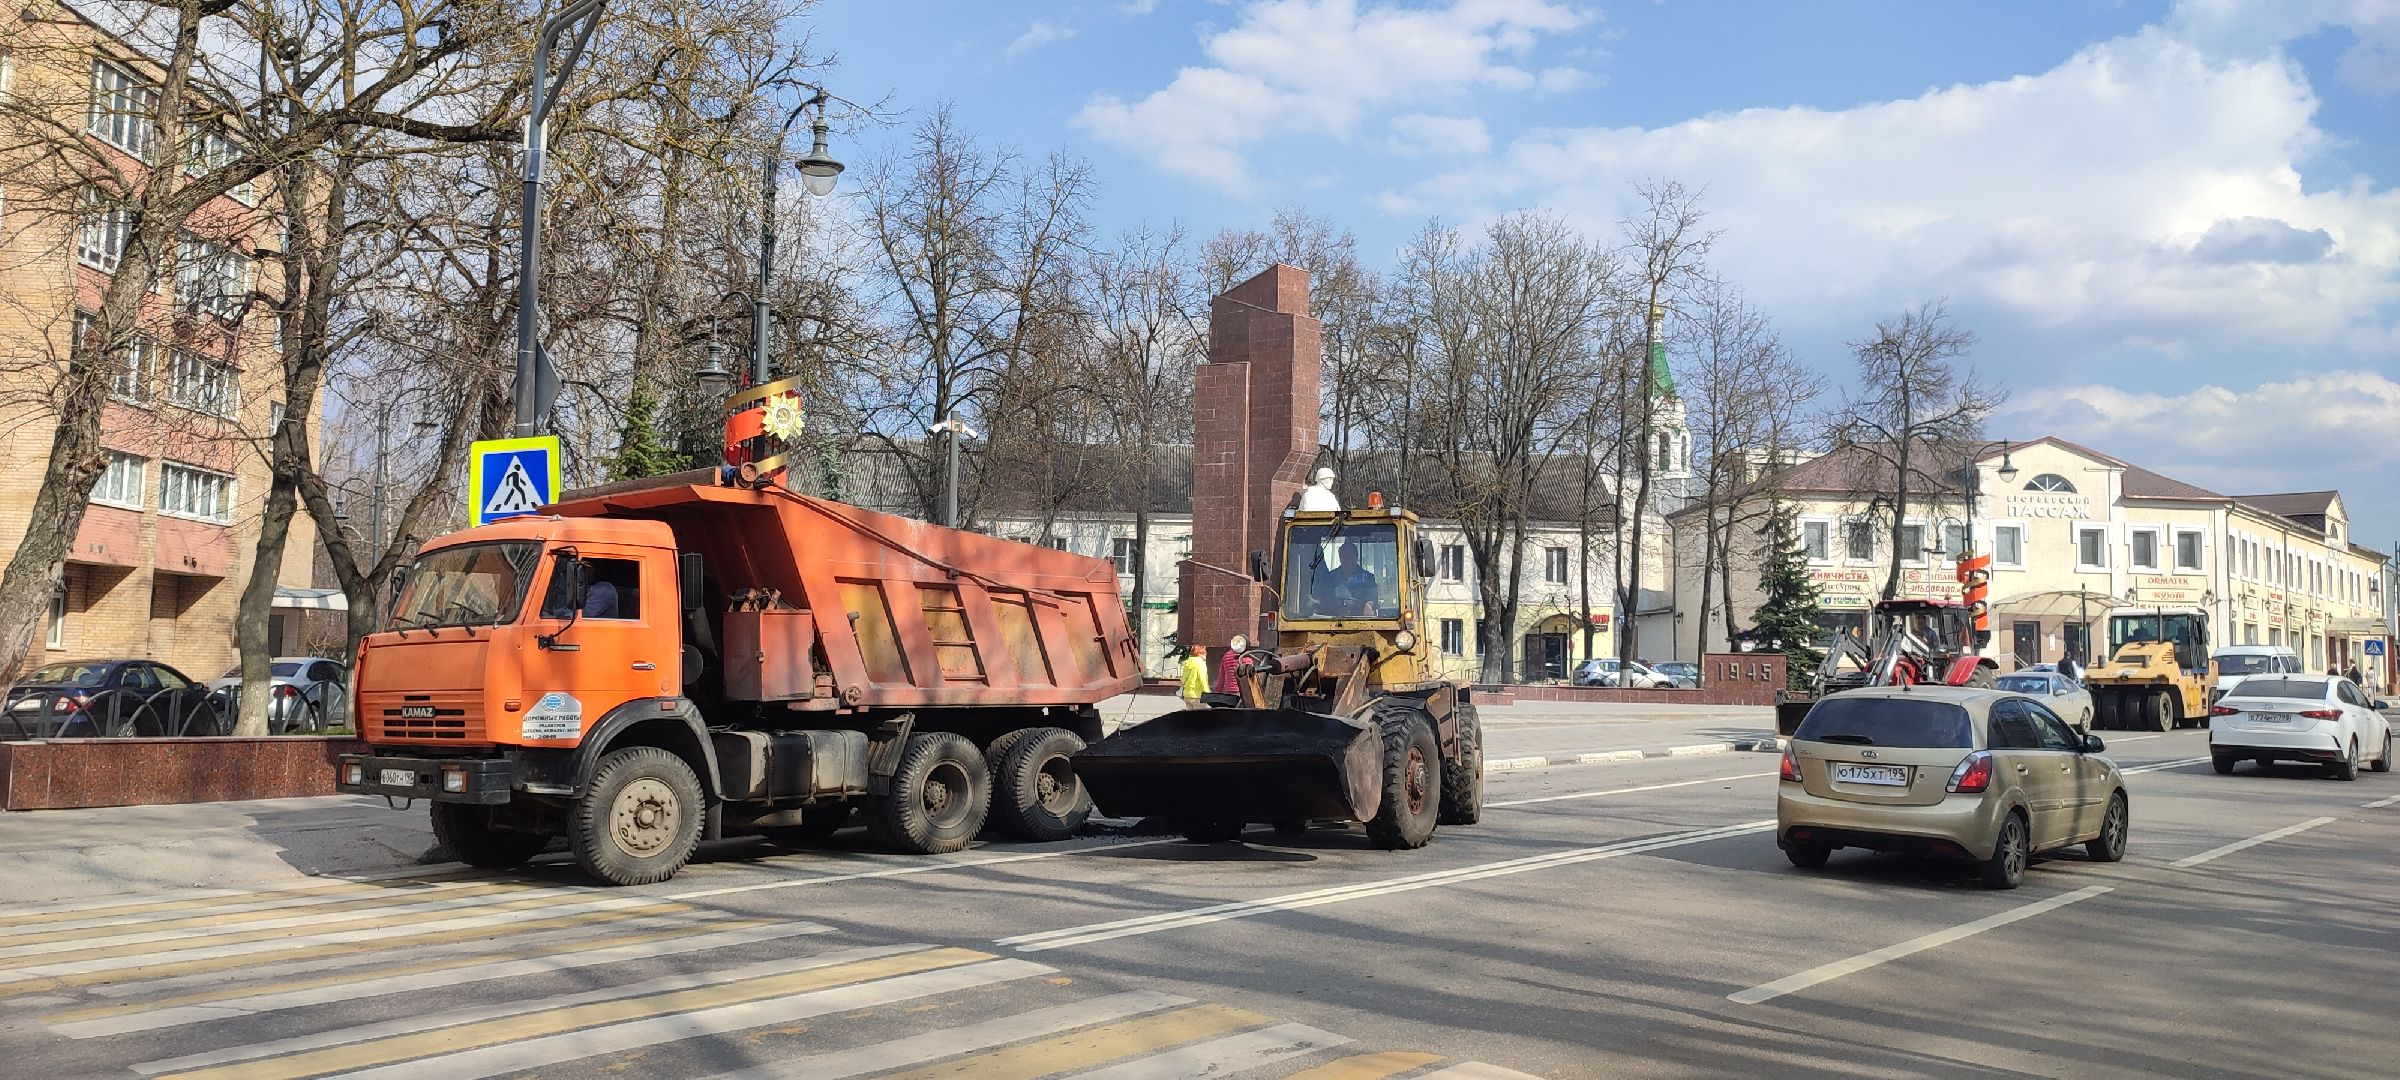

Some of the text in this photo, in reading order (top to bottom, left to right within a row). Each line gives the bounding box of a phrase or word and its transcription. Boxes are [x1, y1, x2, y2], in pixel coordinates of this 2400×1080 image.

[2007, 504, 2090, 519] ПАССАЖ
[1718, 662, 1772, 681] 1945
[402, 707, 433, 717] KAMAZ
